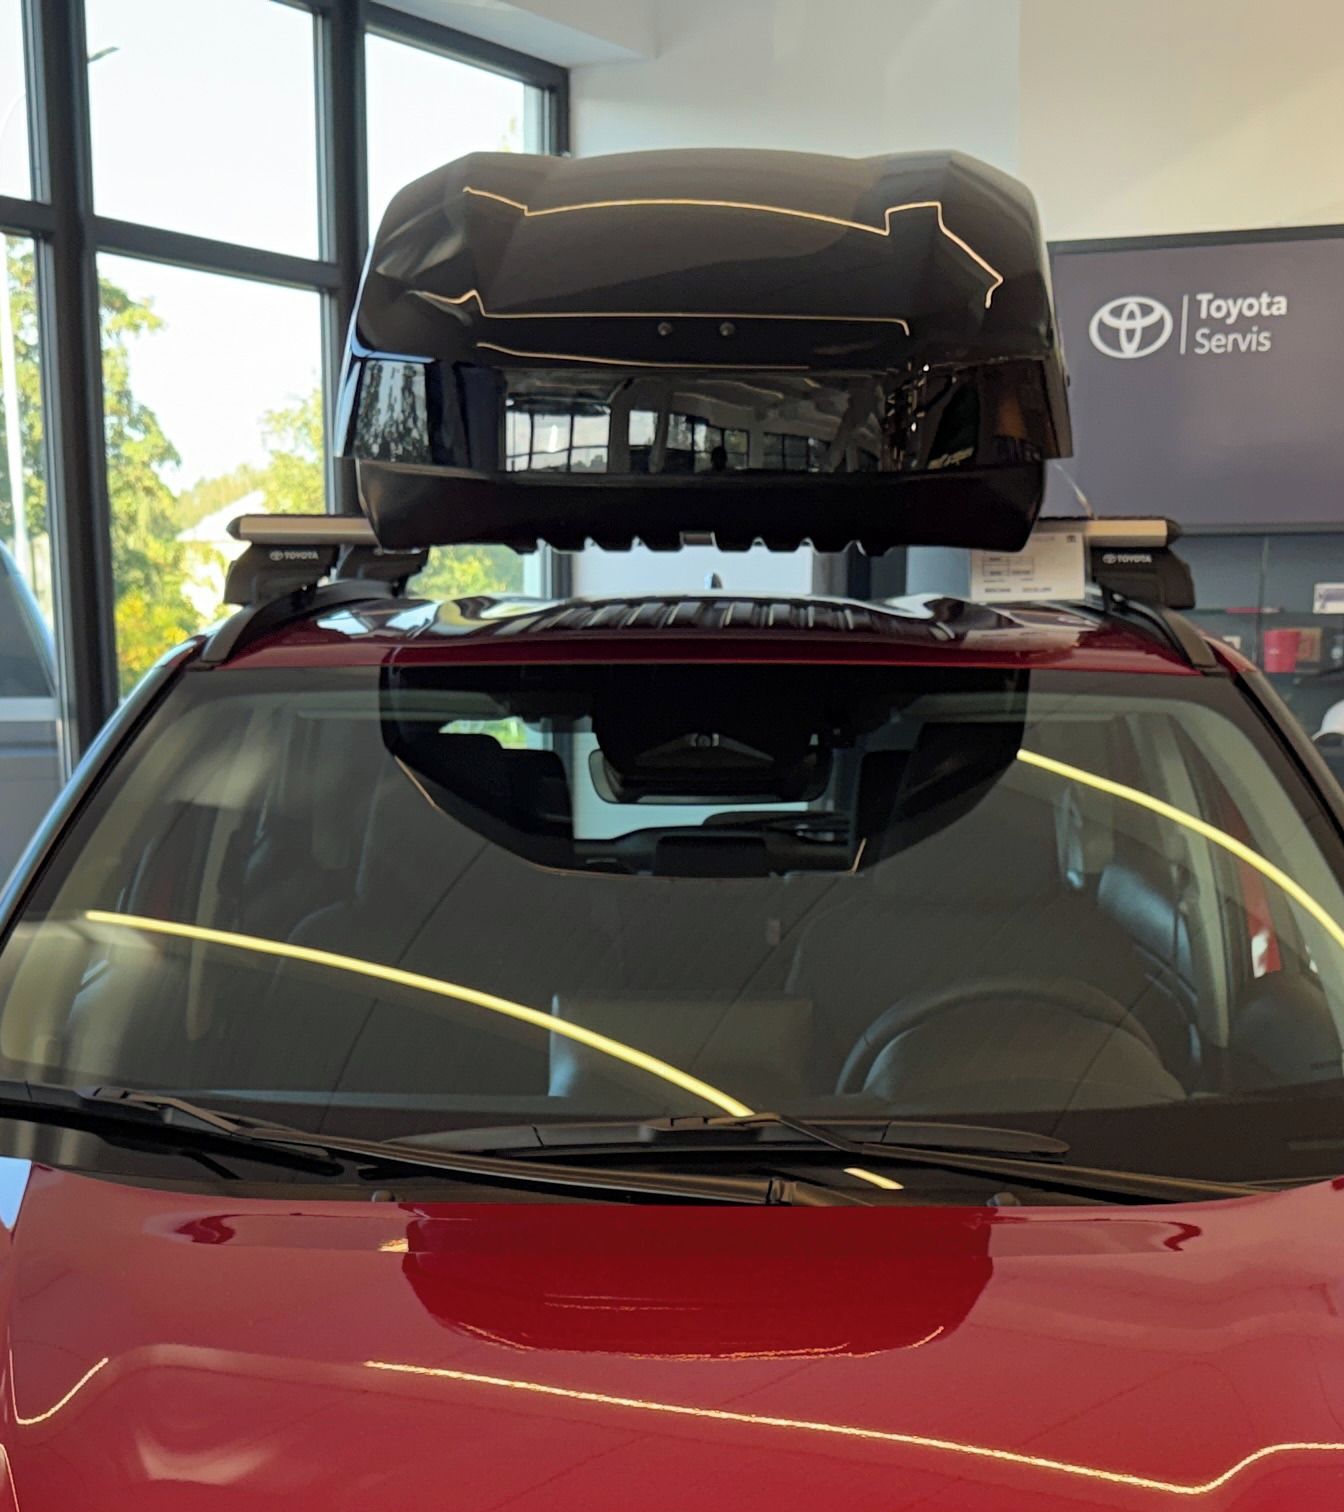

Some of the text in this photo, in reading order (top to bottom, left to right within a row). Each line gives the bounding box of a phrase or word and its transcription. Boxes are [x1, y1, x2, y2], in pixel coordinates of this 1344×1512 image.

[1196, 291, 1288, 325] Toyota
[1194, 326, 1272, 355] Servis
[284, 551, 319, 560] TOYOTA
[1117, 554, 1152, 564] TOYOTA
